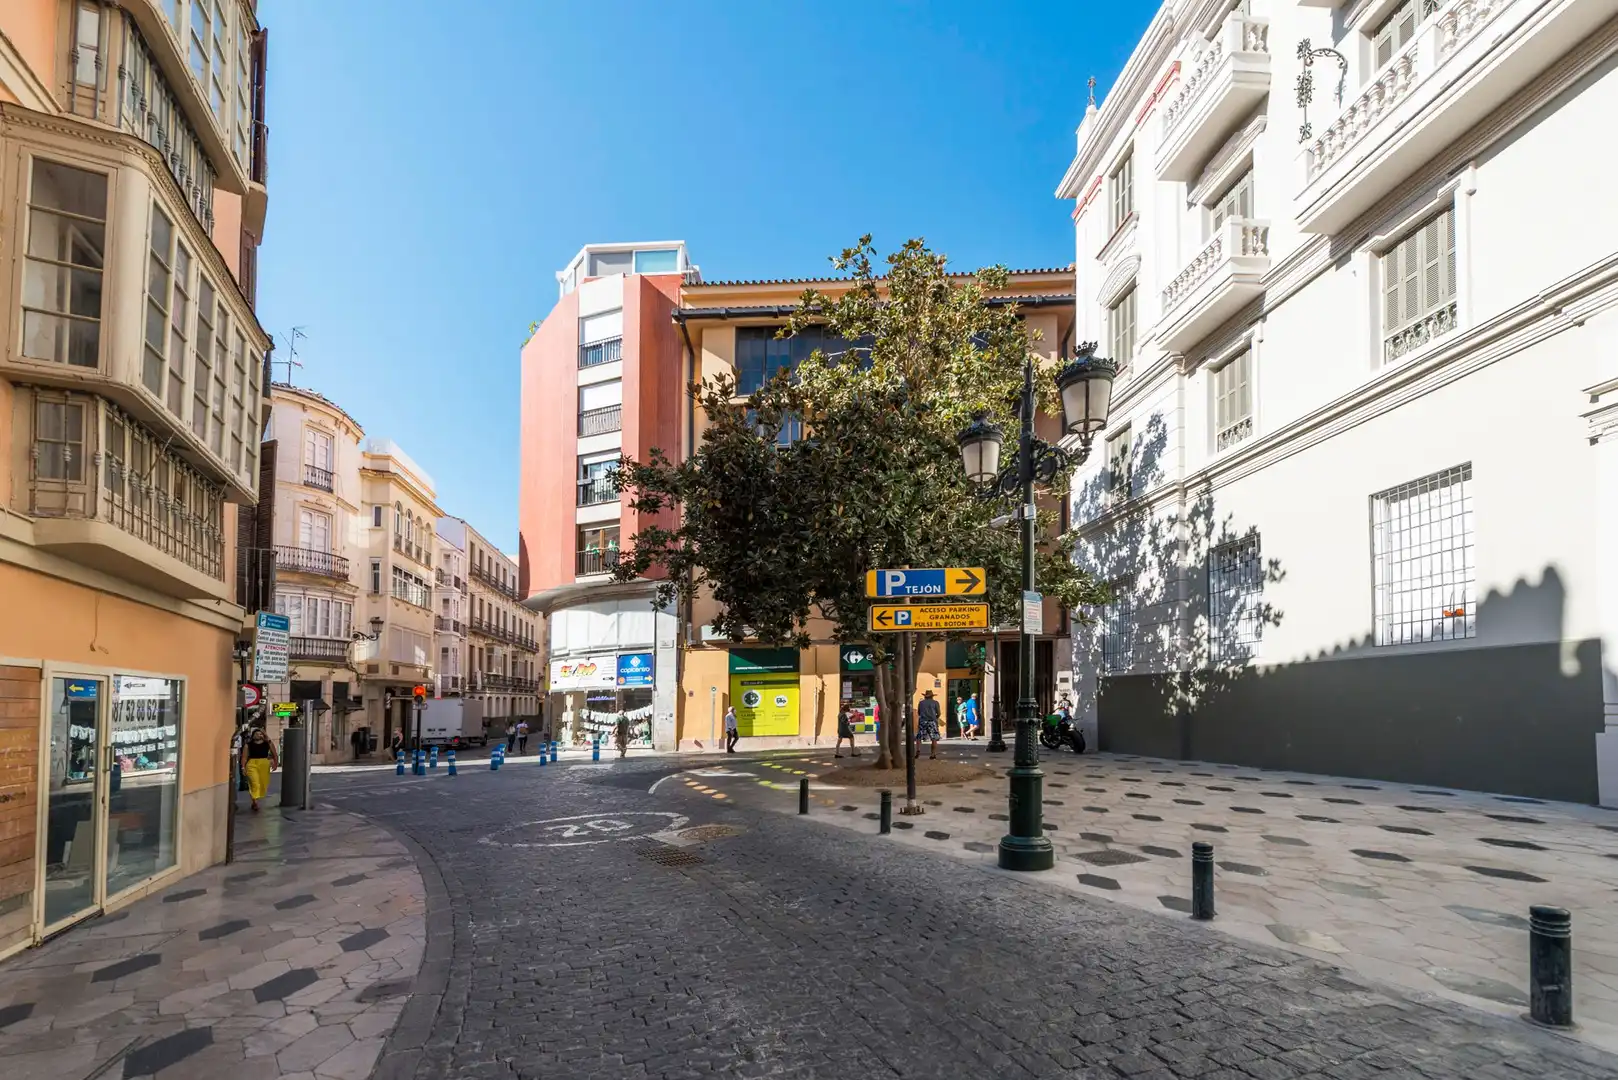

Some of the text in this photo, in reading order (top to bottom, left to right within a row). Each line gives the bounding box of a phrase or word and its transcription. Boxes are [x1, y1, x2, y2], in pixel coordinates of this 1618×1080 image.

[885, 570, 941, 596] P TEJÓN
[897, 611, 909, 624] P
[126, 699, 135, 722] 52
[147, 698, 158, 720] 62
